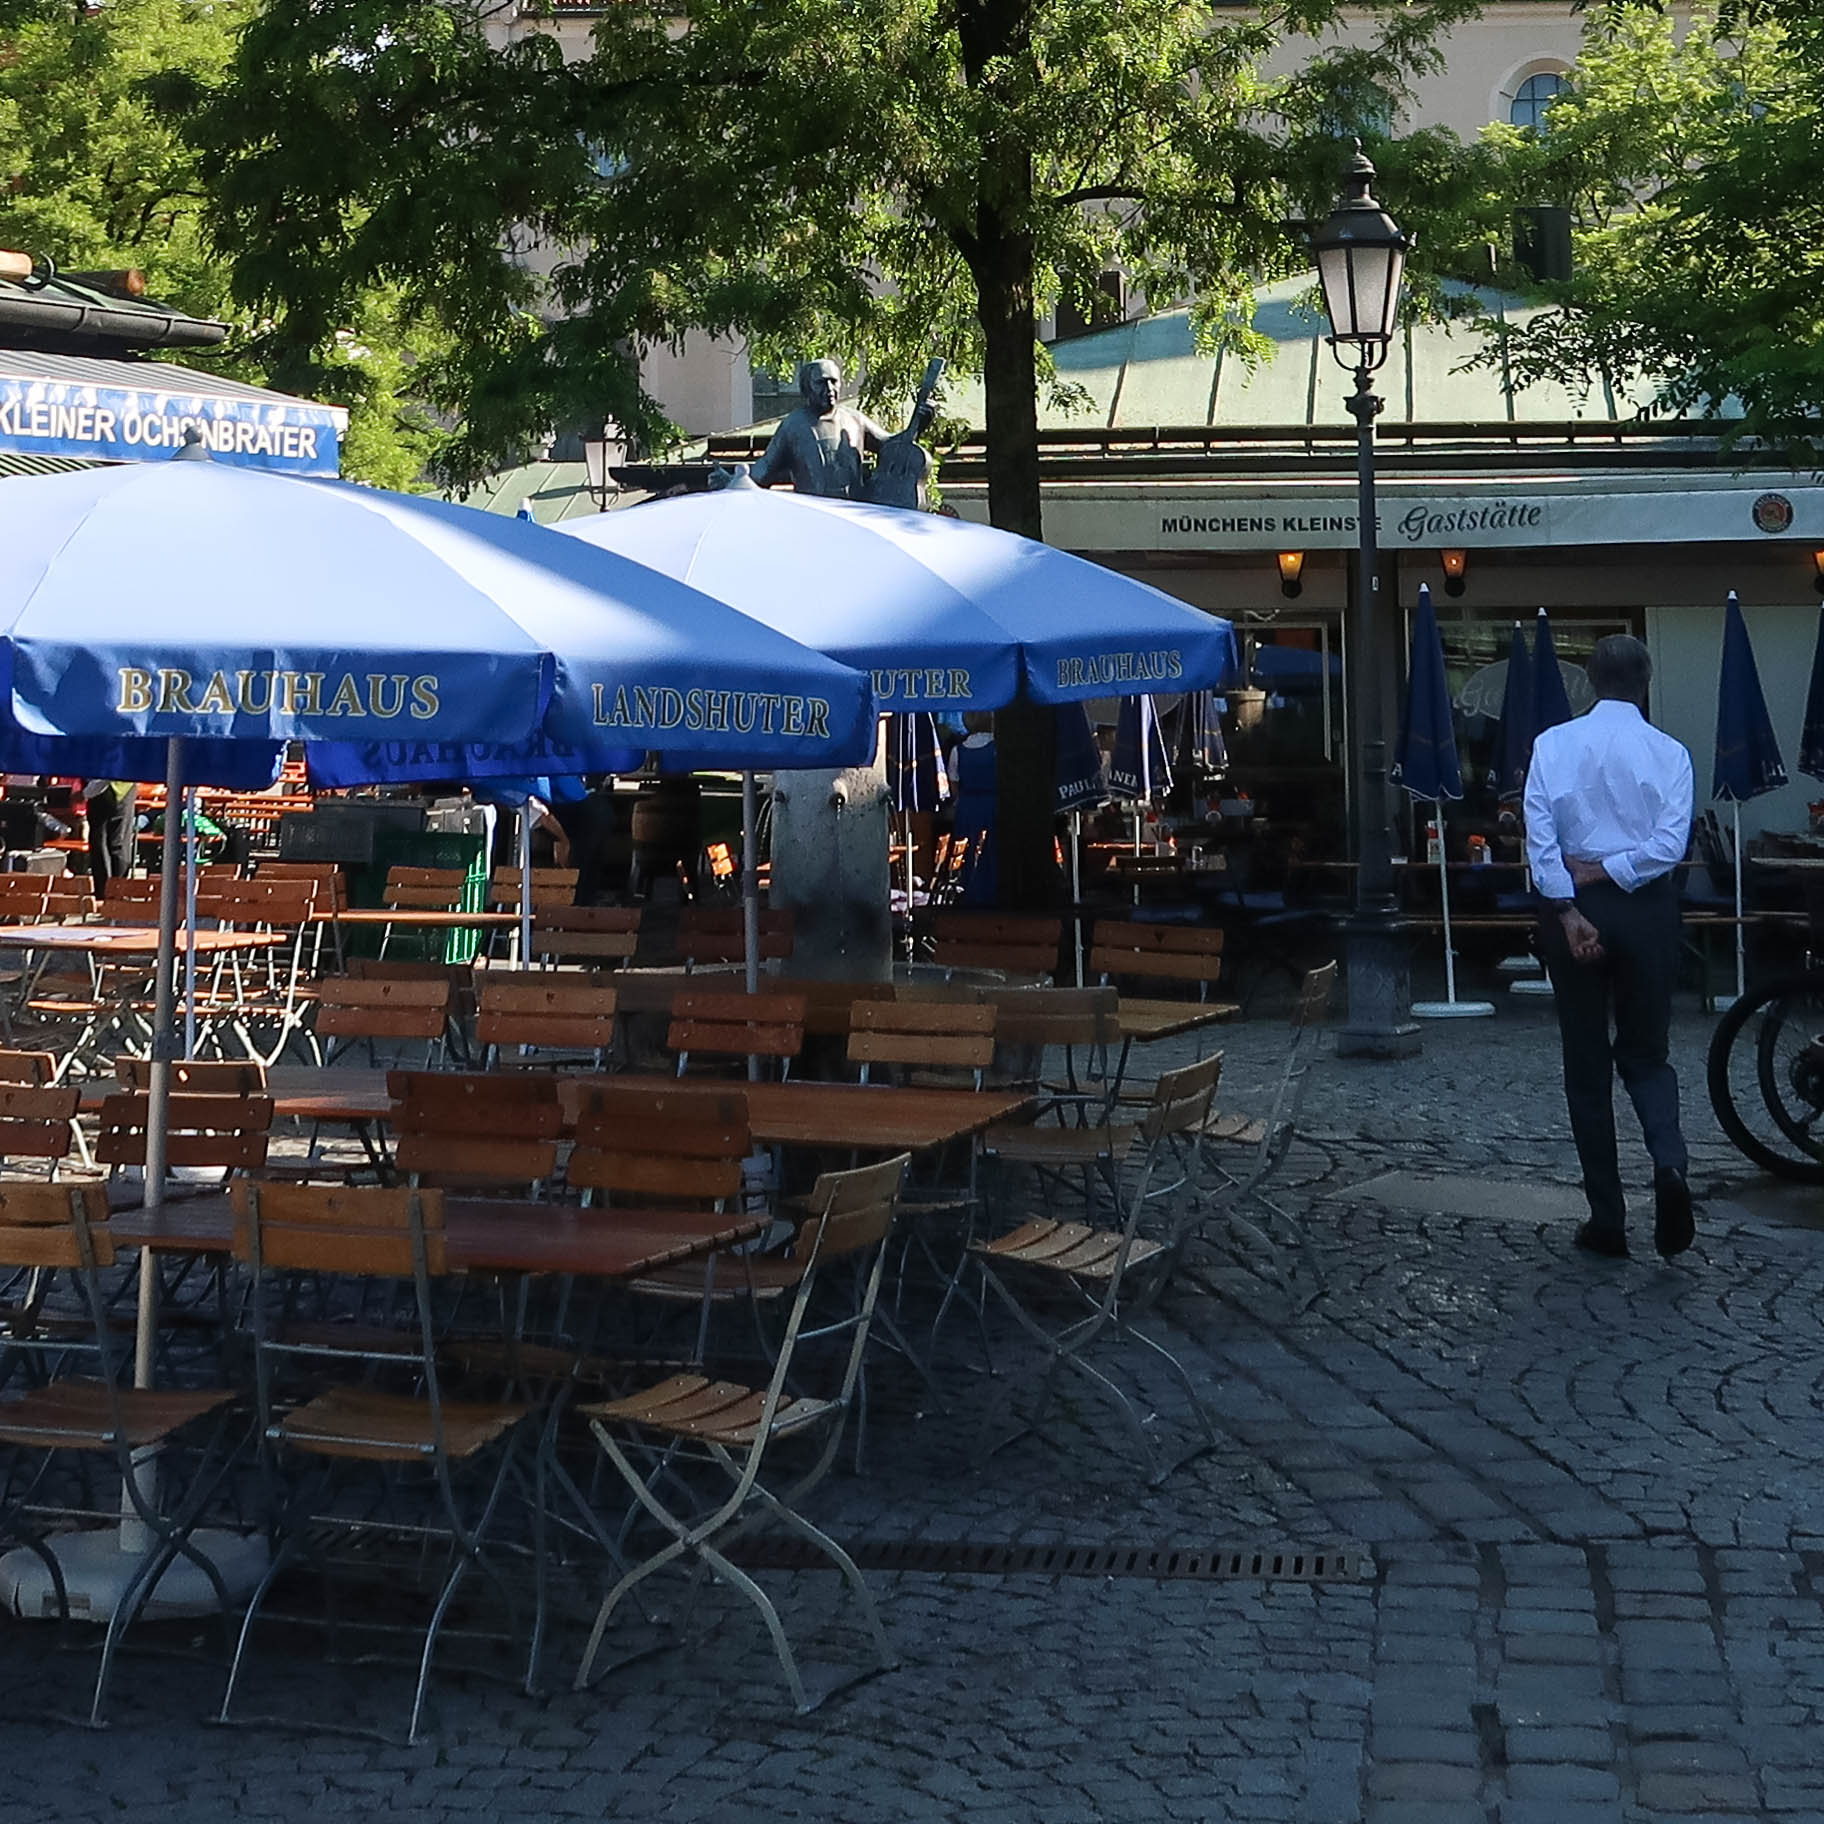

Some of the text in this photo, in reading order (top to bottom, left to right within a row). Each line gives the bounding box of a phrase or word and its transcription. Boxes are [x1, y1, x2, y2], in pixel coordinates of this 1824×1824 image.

[1161, 501, 1542, 542] MÜNCHENS KLEINSE Gaststätte
[117, 666, 440, 719] BRAUHAUS
[1057, 650, 1183, 689] BRAUHAUS
[590, 682, 831, 740] LANDSHUTER
